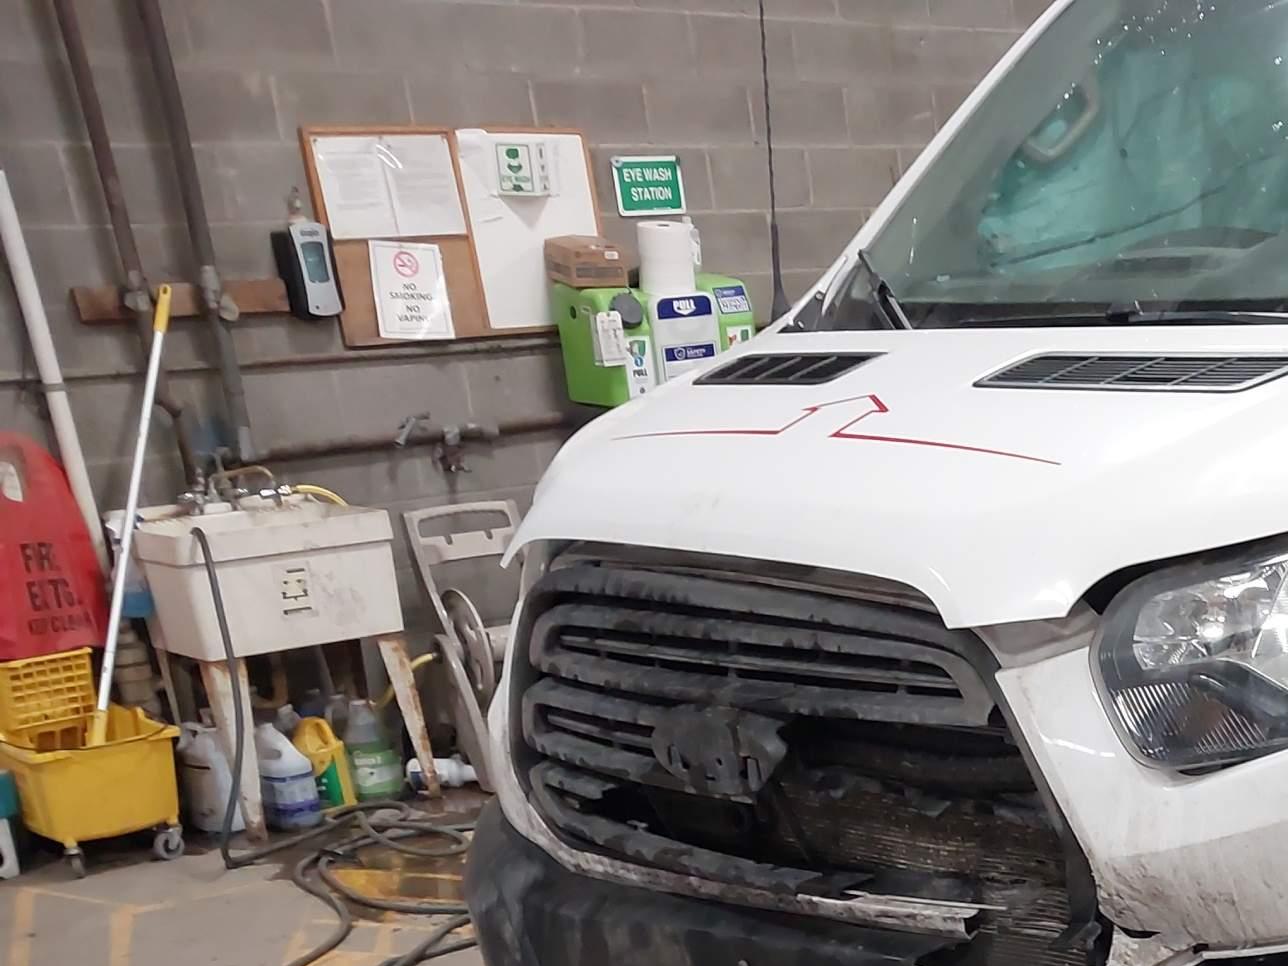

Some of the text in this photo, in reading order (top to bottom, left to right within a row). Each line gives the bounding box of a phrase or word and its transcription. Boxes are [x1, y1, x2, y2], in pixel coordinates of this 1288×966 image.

[623, 167, 673, 183] EYE WASH
[631, 187, 673, 201] STATION
[402, 282, 417, 292] NO
[389, 291, 433, 301] SMOKING
[406, 304, 420, 313] NO
[396, 313, 429, 322] VAPIN
